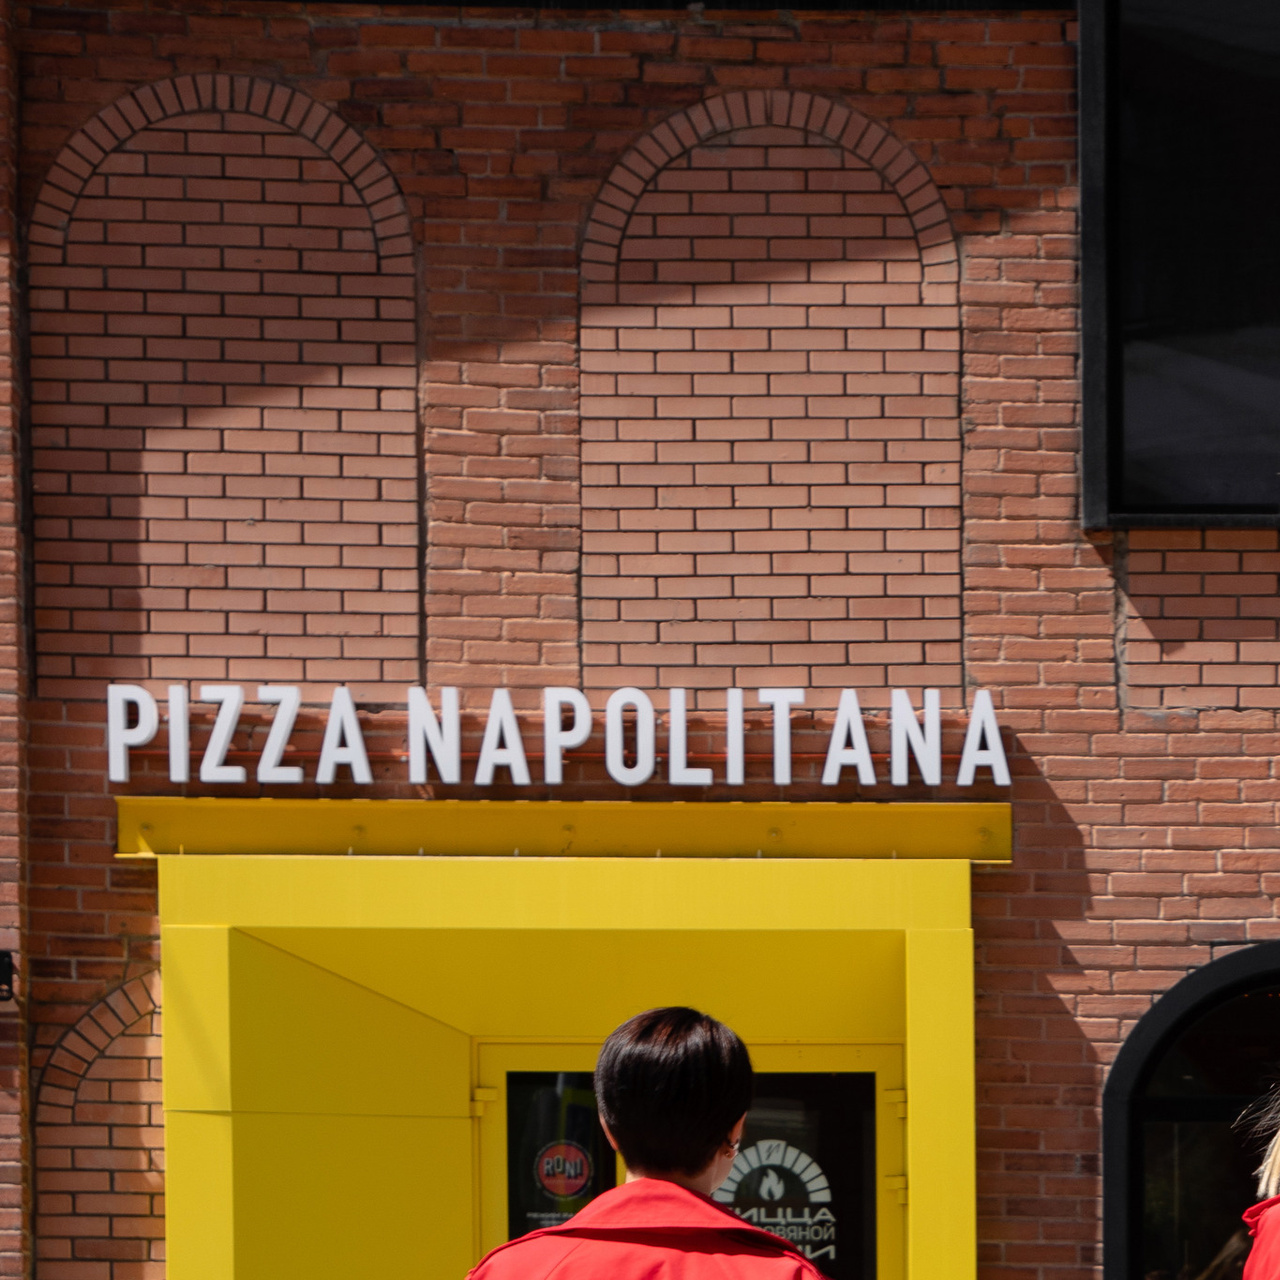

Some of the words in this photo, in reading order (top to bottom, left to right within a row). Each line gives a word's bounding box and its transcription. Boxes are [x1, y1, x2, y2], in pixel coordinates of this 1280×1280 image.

[107, 684, 373, 785] PIZZA
[407, 686, 1012, 787] NAPOLITANA
[543, 1155, 583, 1178] RONI
[727, 1207, 837, 1225] ИЦЦА
